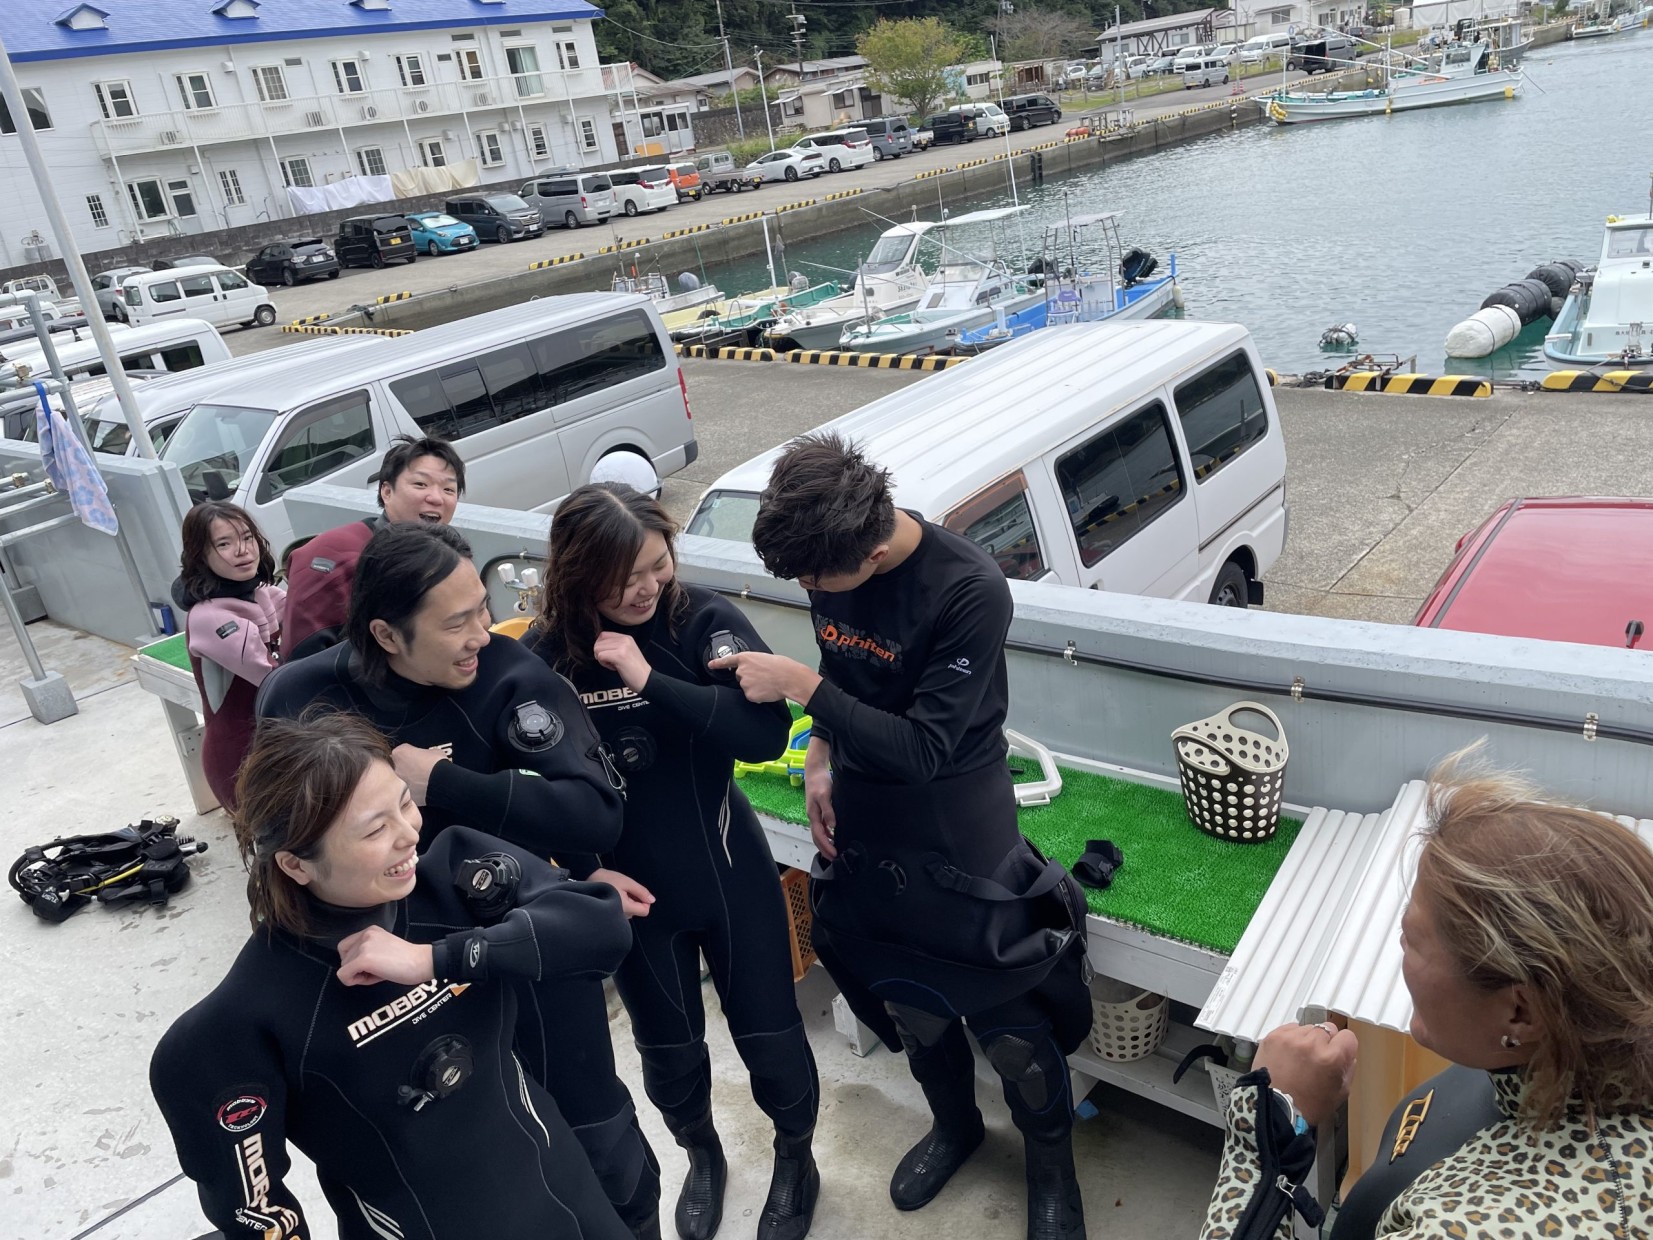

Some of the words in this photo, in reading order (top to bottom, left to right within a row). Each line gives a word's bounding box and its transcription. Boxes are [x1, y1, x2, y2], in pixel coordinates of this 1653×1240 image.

[837, 634, 896, 662] phiten
[579, 686, 638, 705] MOBB
[347, 978, 449, 1041] MOBBY
[411, 1011, 428, 1026] DIVE
[427, 992, 453, 1014] CENTER
